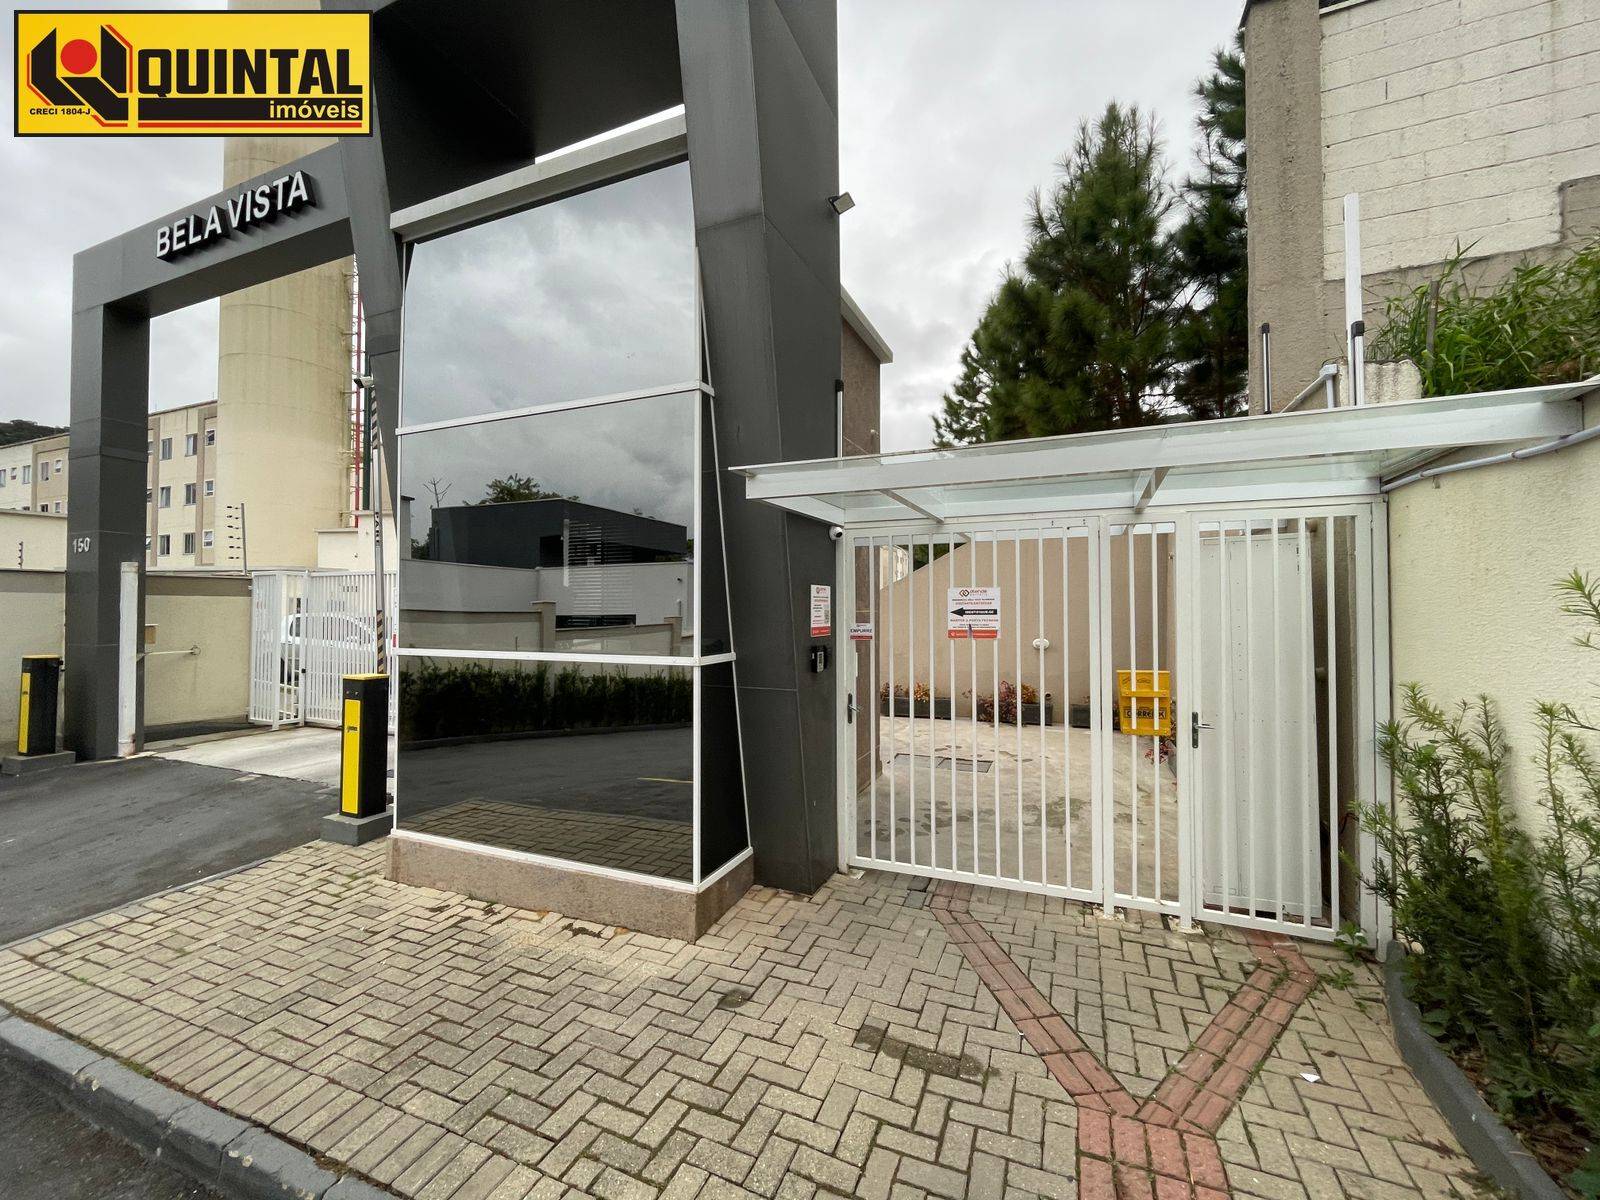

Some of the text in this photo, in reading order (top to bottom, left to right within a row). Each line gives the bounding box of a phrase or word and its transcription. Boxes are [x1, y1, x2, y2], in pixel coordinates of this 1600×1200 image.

[156, 170, 308, 258] BELA VISTA
[72, 537, 90, 553] 150
